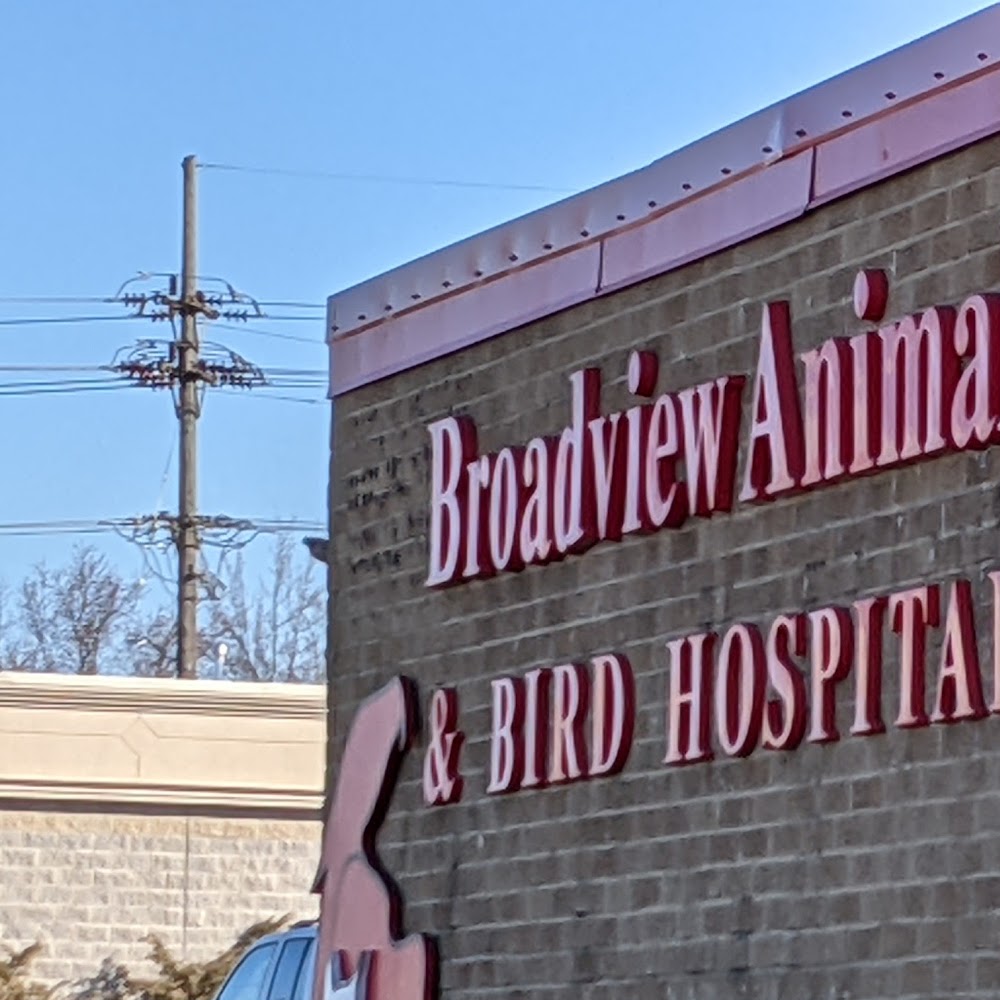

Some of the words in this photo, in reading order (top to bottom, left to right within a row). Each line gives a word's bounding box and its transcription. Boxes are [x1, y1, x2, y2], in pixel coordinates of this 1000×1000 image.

[425, 350, 746, 588] Broadview
[423, 687, 464, 806] &
[487, 652, 635, 793] BIRD
